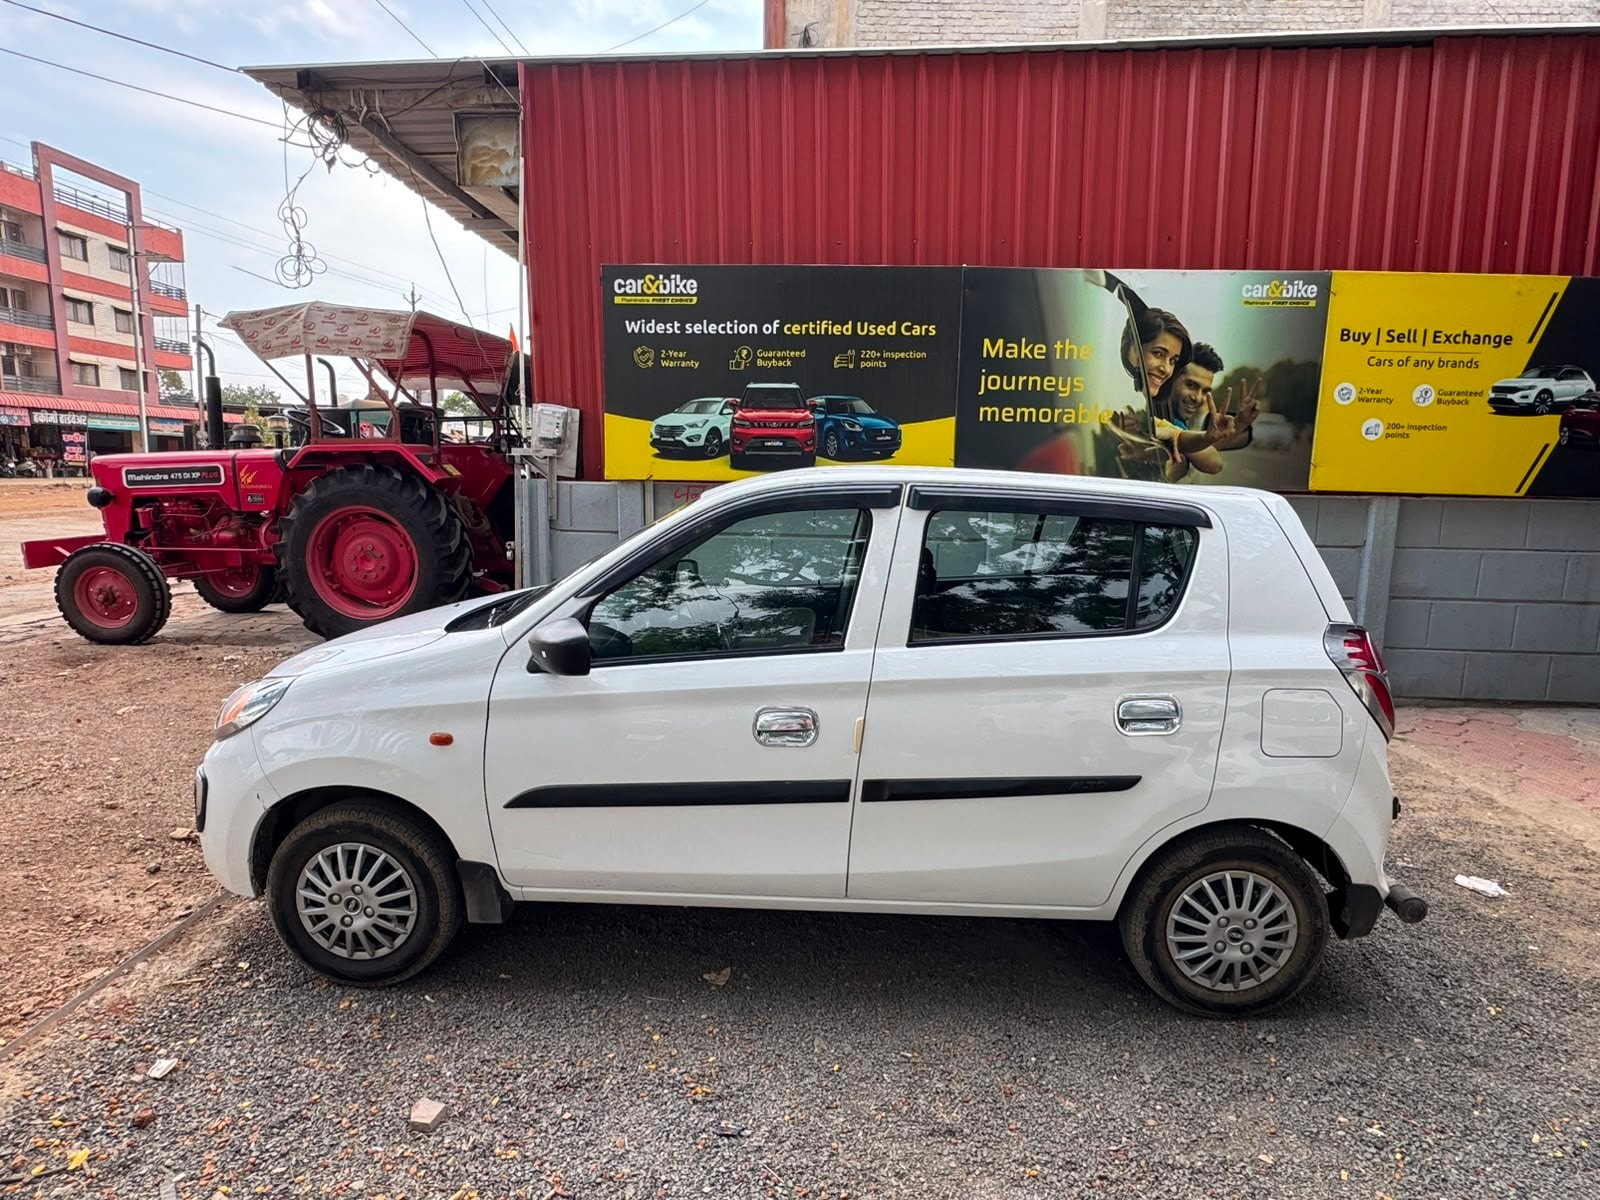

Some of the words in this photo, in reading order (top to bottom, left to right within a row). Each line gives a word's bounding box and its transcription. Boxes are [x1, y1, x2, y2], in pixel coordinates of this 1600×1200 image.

[613, 274, 698, 295] car&bike
[1241, 279, 1319, 298] car&bike
[625, 319, 682, 335] Widest
[684, 319, 758, 335] selection
[762, 319, 780, 335] of
[783, 320, 853, 336] certified
[857, 321, 897, 336] Used
[900, 321, 937, 337] Cars
[1339, 328, 1372, 346] Buy
[1385, 328, 1417, 344] Sell
[1431, 330, 1513, 348] Exchange
[660, 349, 688, 359] 2-Year
[756, 349, 806, 359] Guaranteed
[982, 338, 1047, 360] Make
[1054, 337, 1094, 360] the
[860, 349, 881, 359] 220+
[882, 349, 927, 361] inspection
[660, 359, 700, 370] Warranty
[756, 358, 792, 369] Buyback
[860, 359, 887, 370] points
[1366, 356, 1394, 368] Cars
[1397, 355, 1411, 368] of
[1413, 359, 1435, 371] any
[1437, 357, 1480, 369] brands
[978, 368, 1085, 398] journeys
[1358, 386, 1383, 395] 2-Year
[1437, 389, 1484, 398] Guaranteed
[1357, 395, 1394, 406] Warranty
[1436, 398, 1469, 407] Buyback
[978, 402, 1113, 426] memorable
[1385, 422, 1406, 431] 200+
[1407, 423, 1448, 433] inspection
[1384, 430, 1411, 440] points
[127, 473, 169, 481] Mahindra
[170, 472, 183, 480] 475
[191, 471, 201, 479] XP
[201, 471, 219, 479] PLUS
